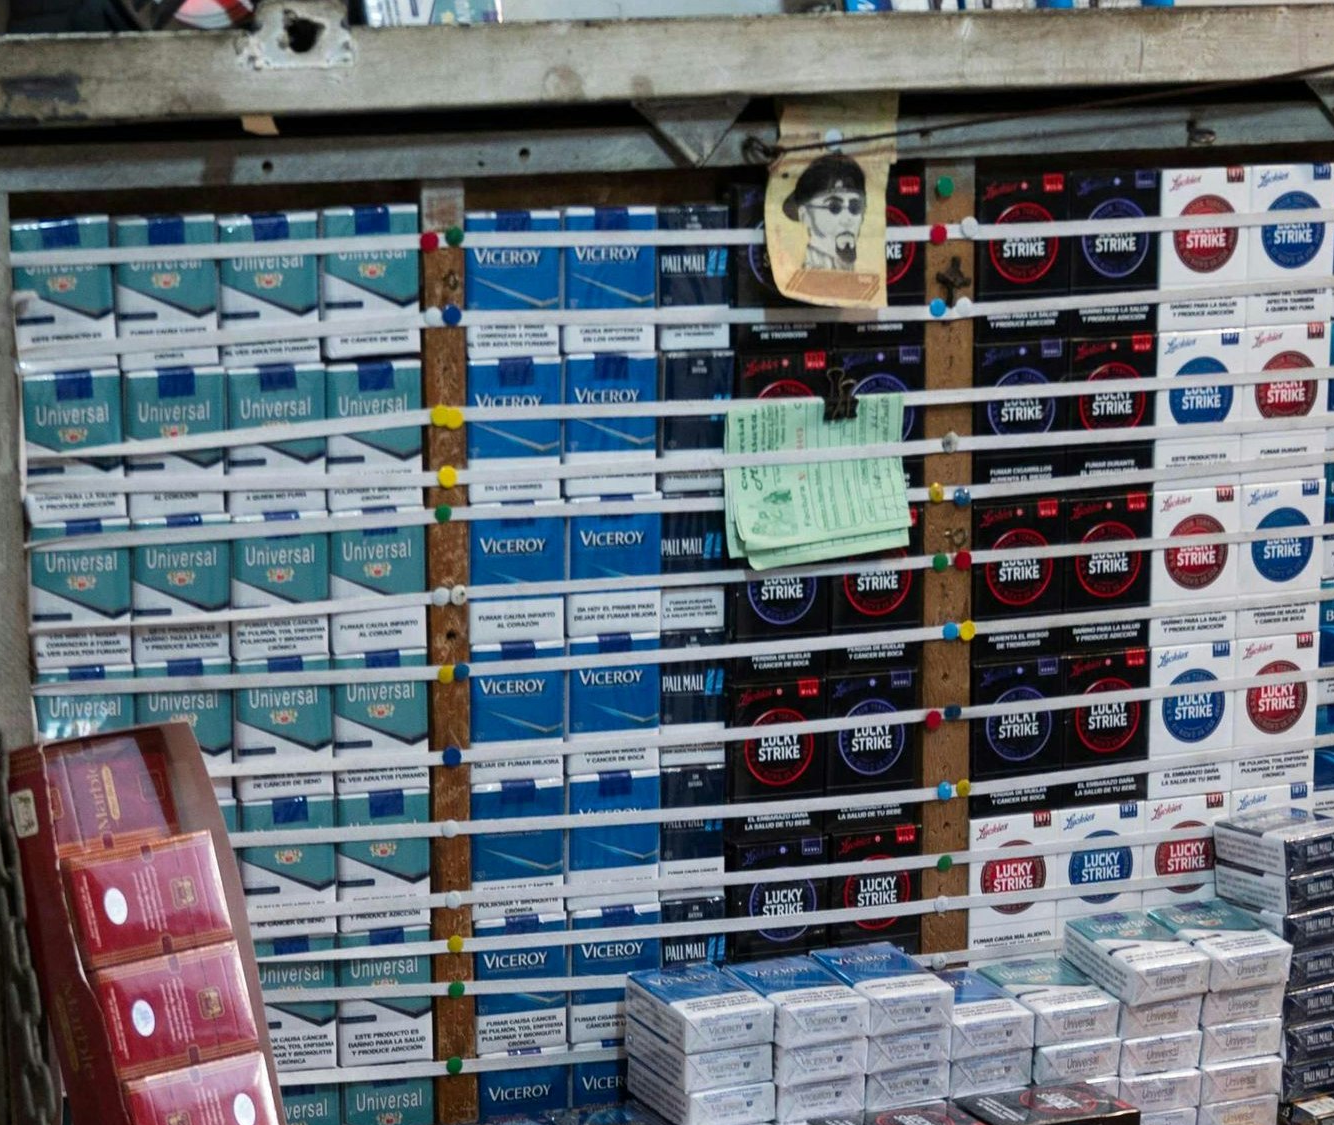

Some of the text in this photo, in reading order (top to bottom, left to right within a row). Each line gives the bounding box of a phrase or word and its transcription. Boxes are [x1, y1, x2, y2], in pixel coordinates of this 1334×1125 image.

[1095, 237, 1136, 253] STRIKE
[1186, 233, 1226, 249] STRIKE
[1274, 229, 1313, 244] STRIKE
[473, 248, 541, 265] VICEROY
[574, 245, 640, 262] VICEROY
[1003, 242, 1045, 258] STRIKE
[661, 253, 706, 273] PALL MALL
[1182, 393, 1221, 410] STRIKE
[1267, 387, 1305, 404] STRIKE
[137, 400, 211, 423] Universal
[240, 397, 312, 419] Universal
[338, 393, 408, 416] Universal
[1001, 404, 1043, 422] STRIKE
[1092, 399, 1133, 416] STRIKE
[35, 404, 110, 427] Universal
[480, 537, 546, 556] VICEROY
[579, 530, 645, 548] VICEROY
[661, 538, 703, 556] PALL MALL
[146, 547, 217, 569] Universal
[245, 543, 315, 566] Universal
[343, 538, 412, 561] Universal
[45, 550, 118, 573] Universal
[1088, 557, 1129, 575] STRIKE
[999, 565, 1040, 582] STRIKE
[857, 574, 899, 592] STRIKE
[761, 585, 804, 600] STRIKE
[579, 670, 643, 686] VICEROY
[662, 675, 704, 692] PALL MALL
[347, 680, 415, 701] Universal
[480, 679, 546, 695] VICEROY
[1261, 684, 1295, 698] LUCKY
[148, 690, 218, 711] Universal
[249, 688, 318, 709] Universal
[1178, 694, 1212, 707] LUCKY
[49, 697, 122, 718] Universal
[1091, 703, 1126, 715] LUCKY
[854, 724, 890, 737] LUCKY
[761, 734, 798, 747] LUCKY
[851, 735, 892, 752] STRIKE
[758, 745, 801, 762] STRIKE
[976, 822, 1009, 841] Luckies
[1169, 841, 1205, 855] LUCKY
[1084, 852, 1120, 868] LUCKY
[995, 862, 1033, 879] LUCKY
[859, 876, 897, 893] LUCKY
[765, 888, 804, 905] LUCKY
[581, 942, 644, 959] VICEROY
[665, 942, 706, 961] PALL MALL
[350, 957, 419, 979] Universal
[483, 951, 548, 969] VICEROY
[356, 1088, 423, 1112] Universal
[488, 1084, 552, 1102] VICEROY
